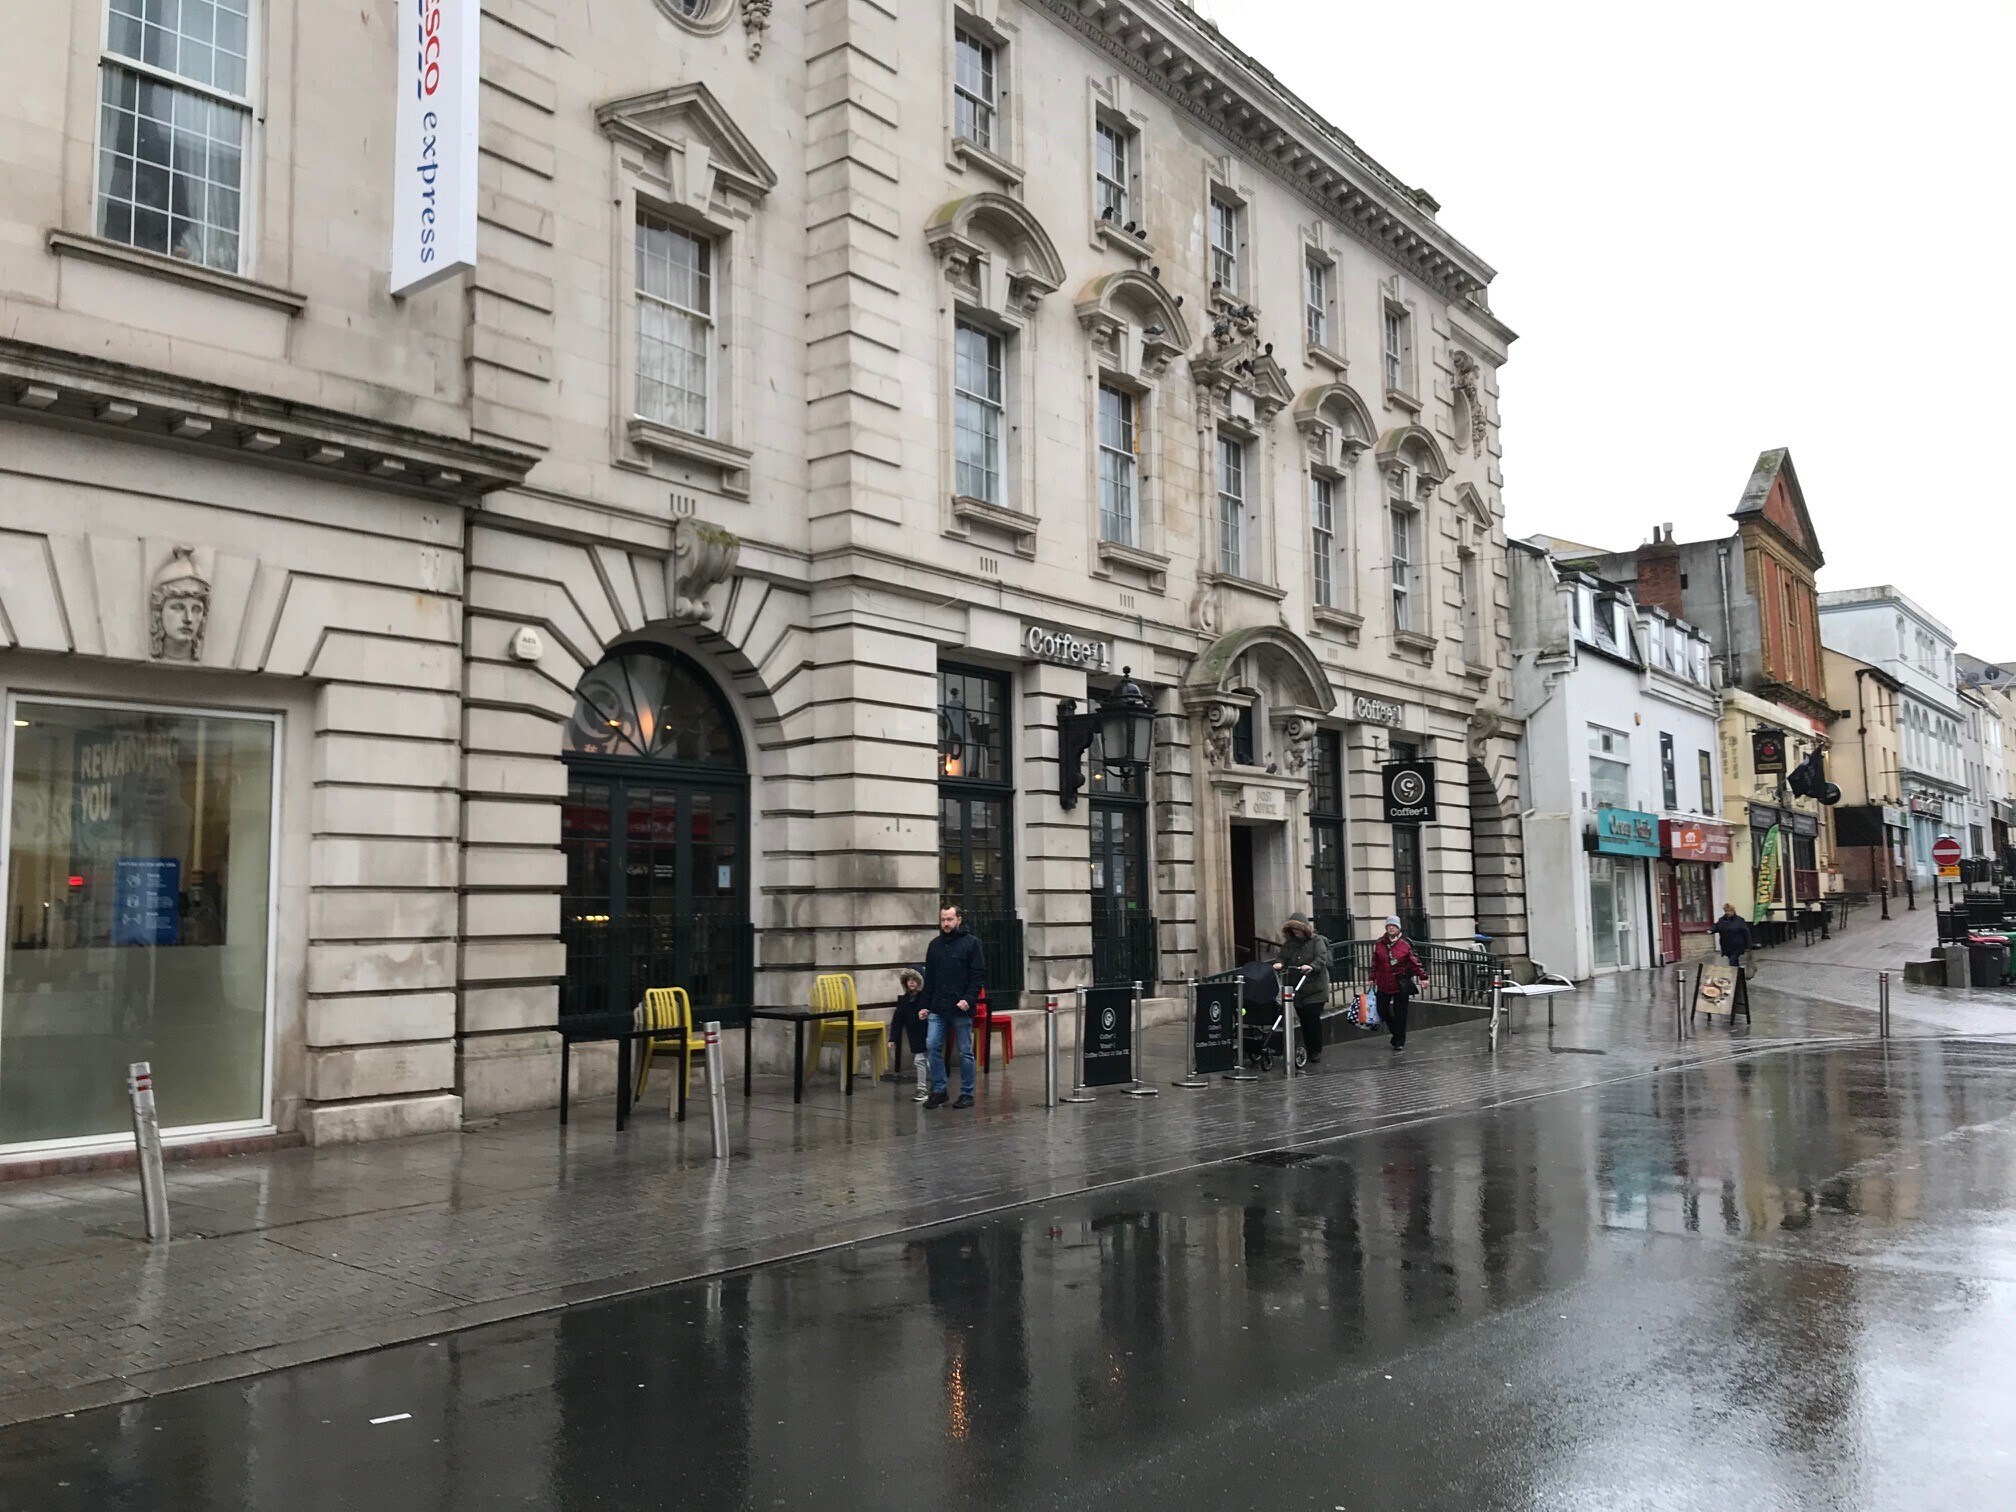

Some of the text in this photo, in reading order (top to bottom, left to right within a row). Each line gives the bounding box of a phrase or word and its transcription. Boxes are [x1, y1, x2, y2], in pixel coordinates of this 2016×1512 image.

[416, 111, 438, 263] express
[81, 783, 112, 823] YOU
[1389, 806, 1429, 817] Coffee#1
